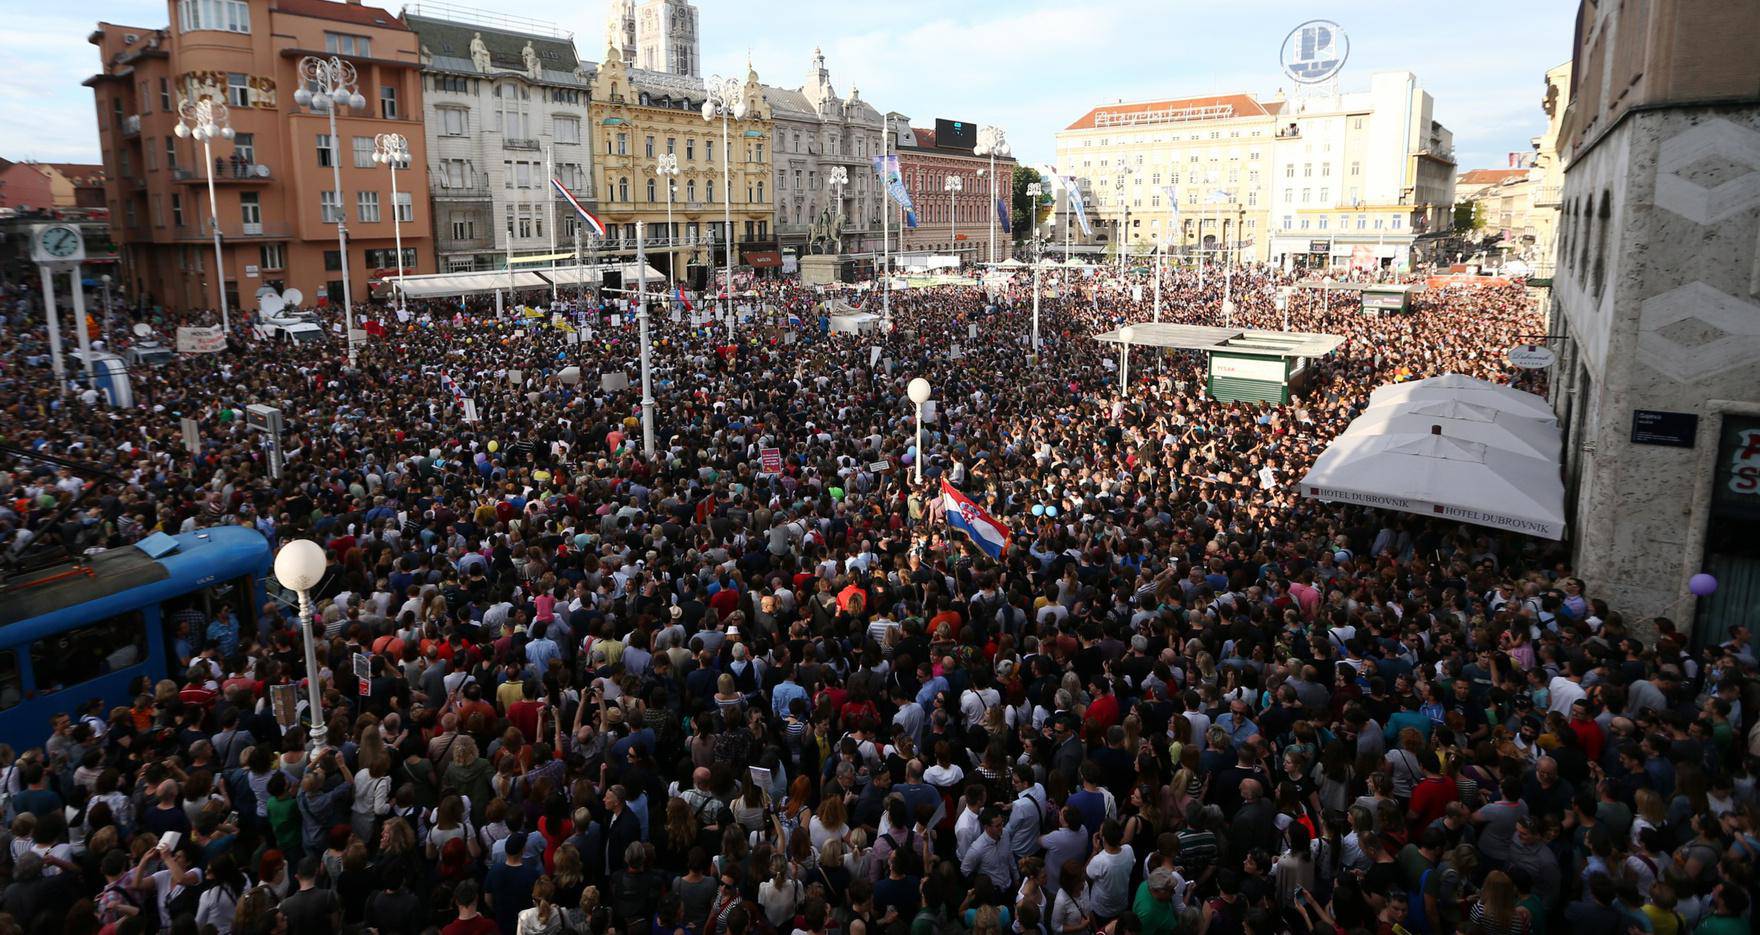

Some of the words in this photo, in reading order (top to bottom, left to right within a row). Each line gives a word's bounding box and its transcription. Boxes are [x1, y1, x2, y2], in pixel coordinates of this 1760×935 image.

[1320, 488, 1349, 499] HOTEL
[1351, 492, 1409, 508] DUBROVNIK
[1445, 507, 1480, 520] HOTEL
[1482, 513, 1549, 534] DUBROVNIK
